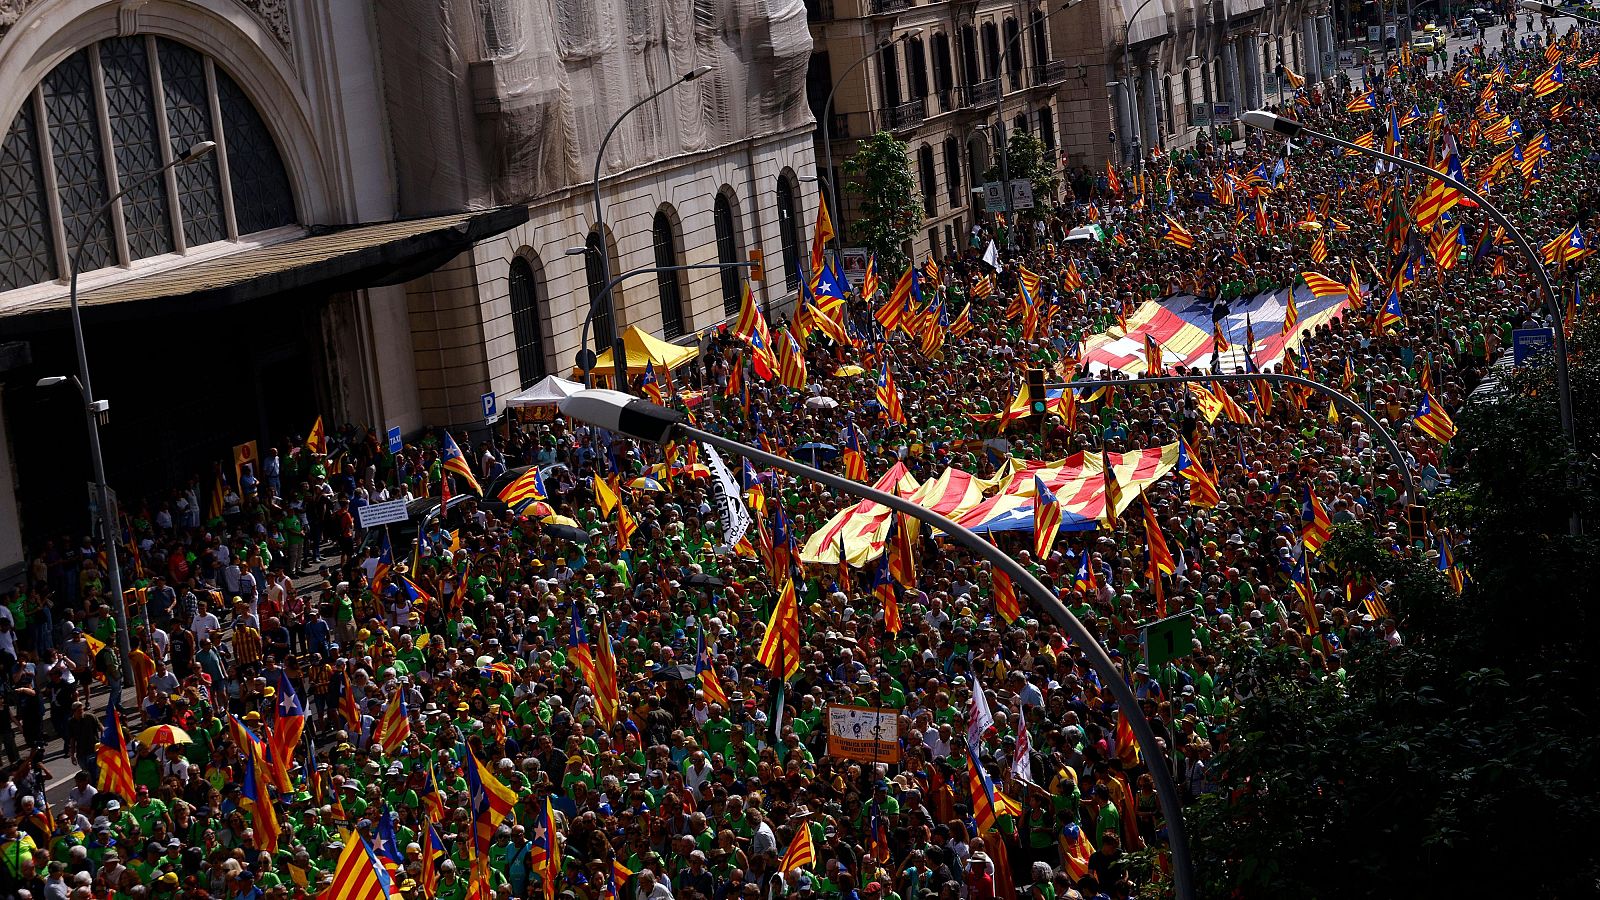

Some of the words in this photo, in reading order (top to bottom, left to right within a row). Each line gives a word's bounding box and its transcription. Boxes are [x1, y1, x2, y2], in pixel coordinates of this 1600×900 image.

[483, 395, 493, 414] P
[389, 434, 401, 445] TAXI
[1163, 630, 1174, 655] 1
